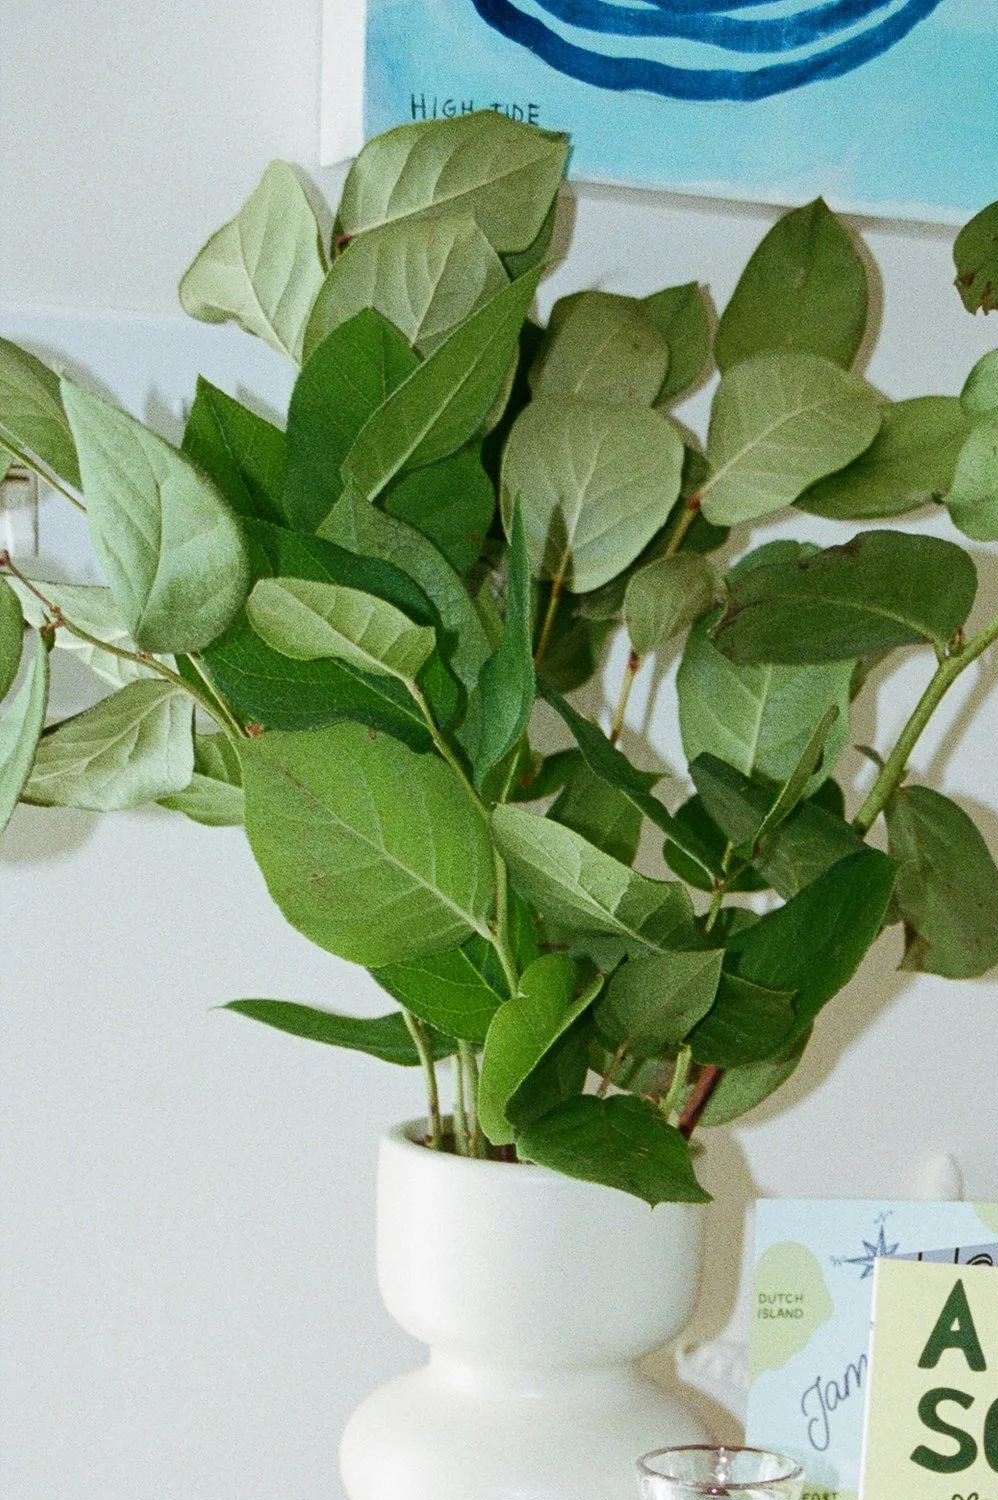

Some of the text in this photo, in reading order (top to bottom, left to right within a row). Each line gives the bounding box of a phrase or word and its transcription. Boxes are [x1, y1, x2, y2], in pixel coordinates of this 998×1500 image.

[410, 93, 474, 120] HIGH
[758, 1293, 804, 1305] DUTCH
[757, 1308, 804, 1320] ISLAND
